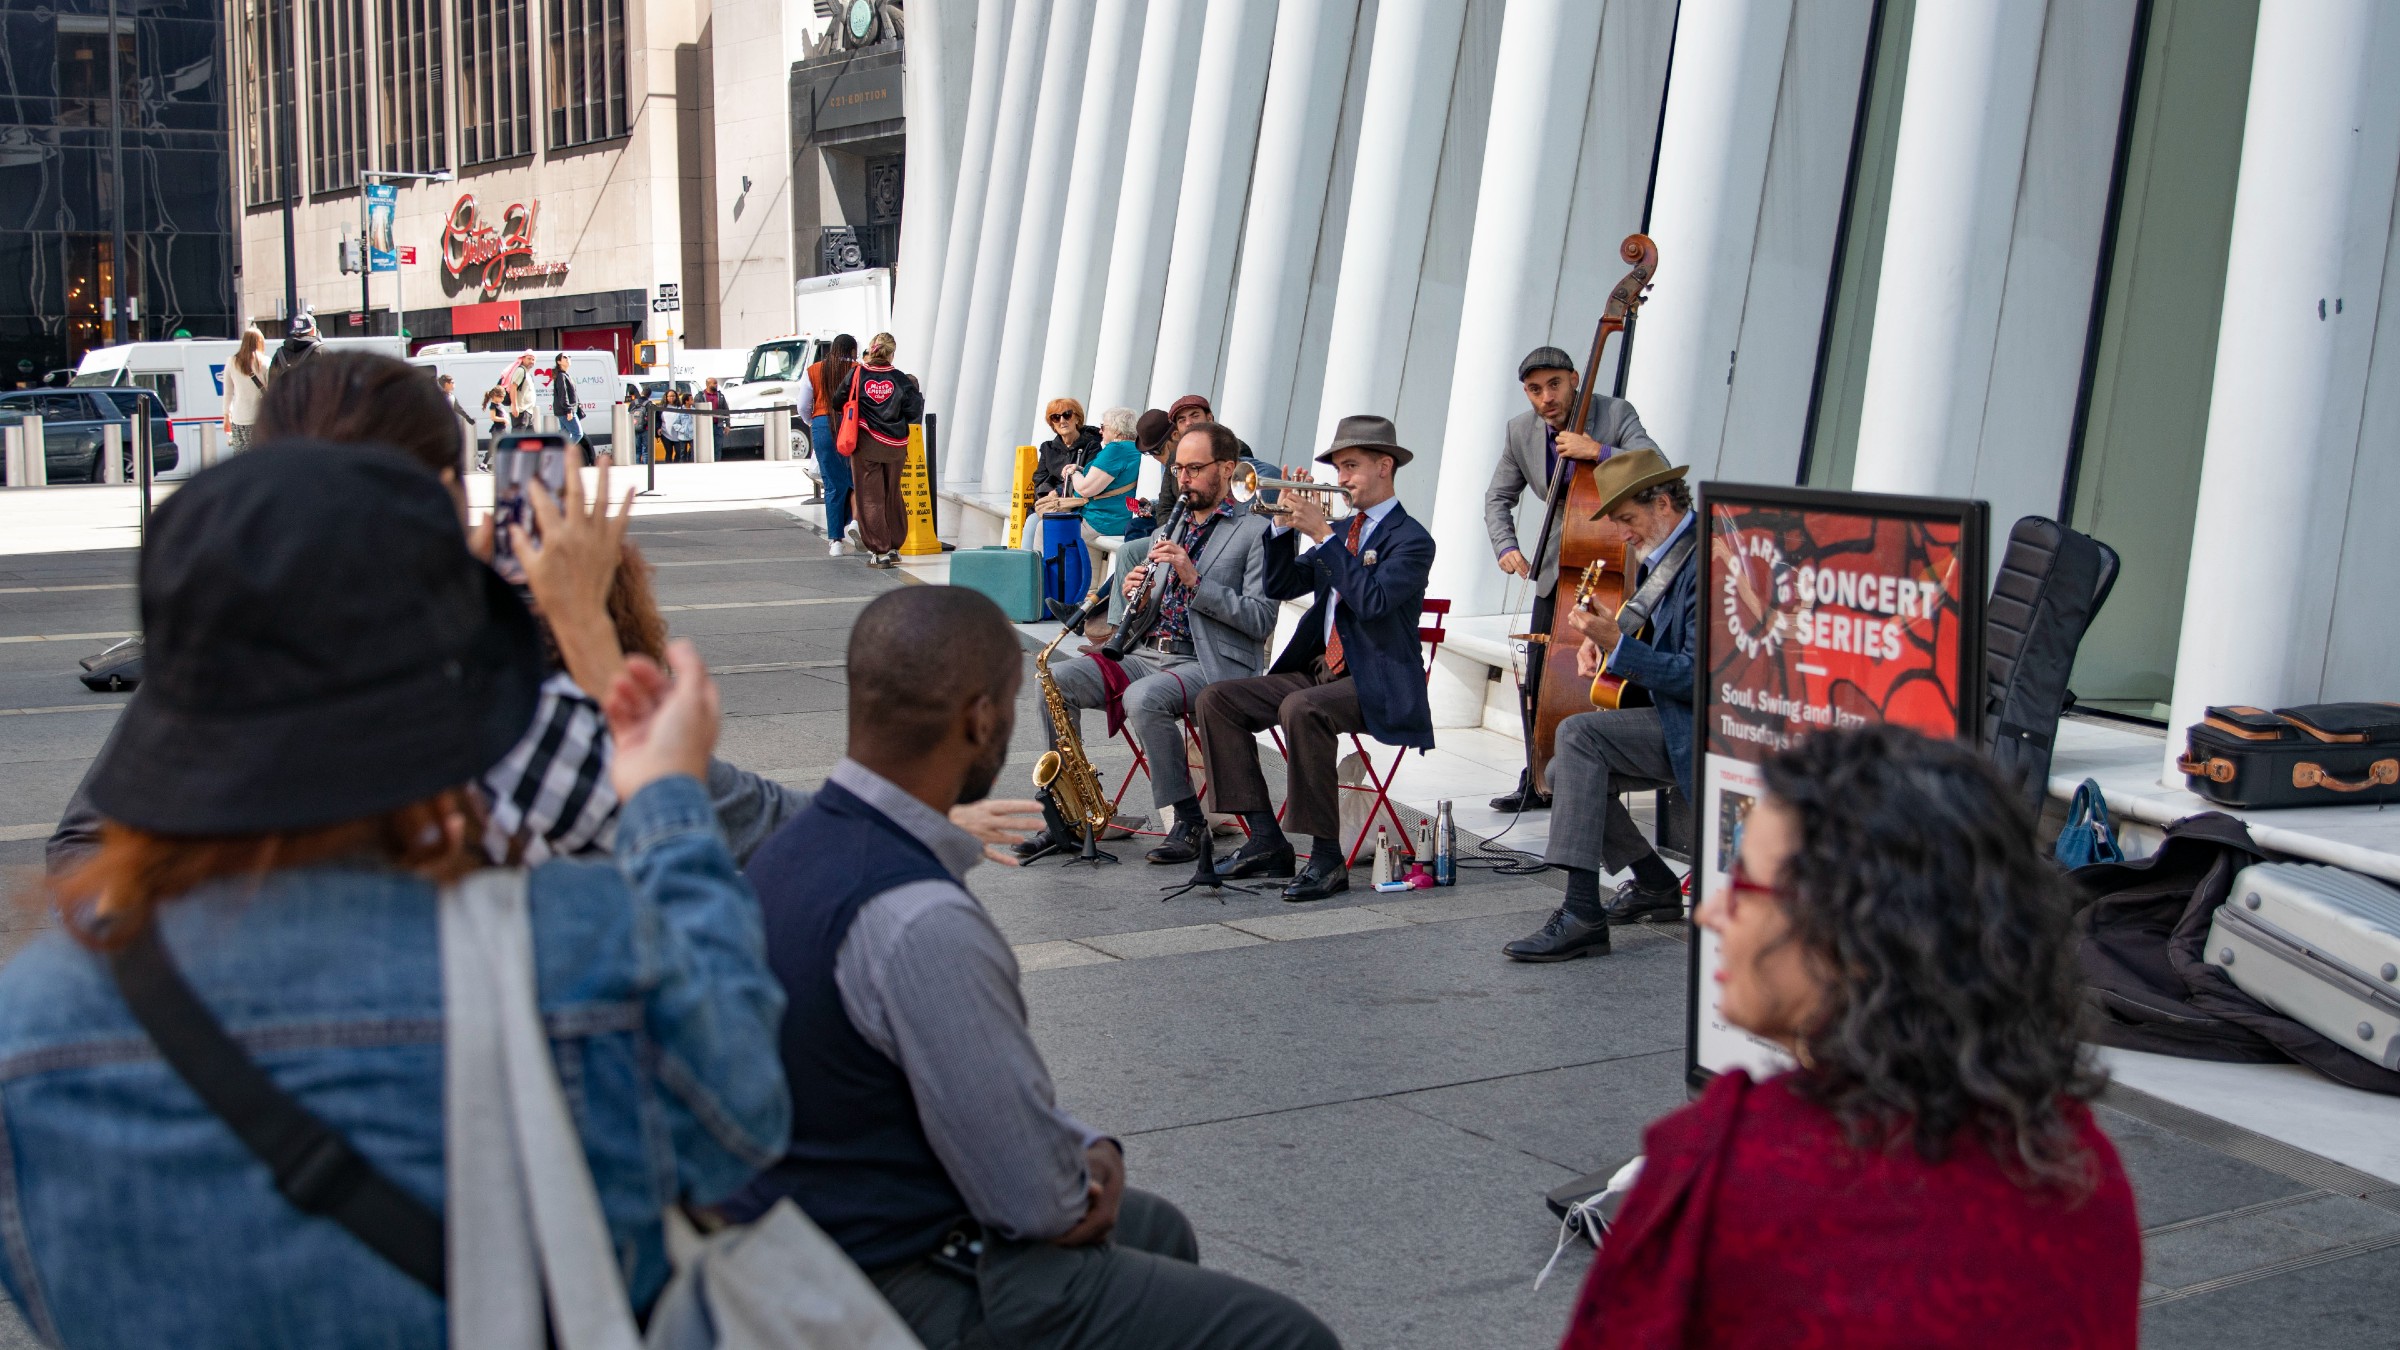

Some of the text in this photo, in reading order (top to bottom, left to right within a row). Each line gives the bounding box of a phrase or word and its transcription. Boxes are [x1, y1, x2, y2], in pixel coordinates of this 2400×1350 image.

[848, 88, 887, 105] EDITION
[444, 193, 537, 291] Century 21
[576, 376, 604, 385] LAMUS
[1723, 535, 1791, 660] ART IS ALL AROUND
[1797, 565, 1936, 621] CONCERT
[1795, 610, 1902, 662] SERIES
[1721, 682, 1867, 731] Soul, Swing and Jazz
[1720, 714, 1790, 752] Thursdays
